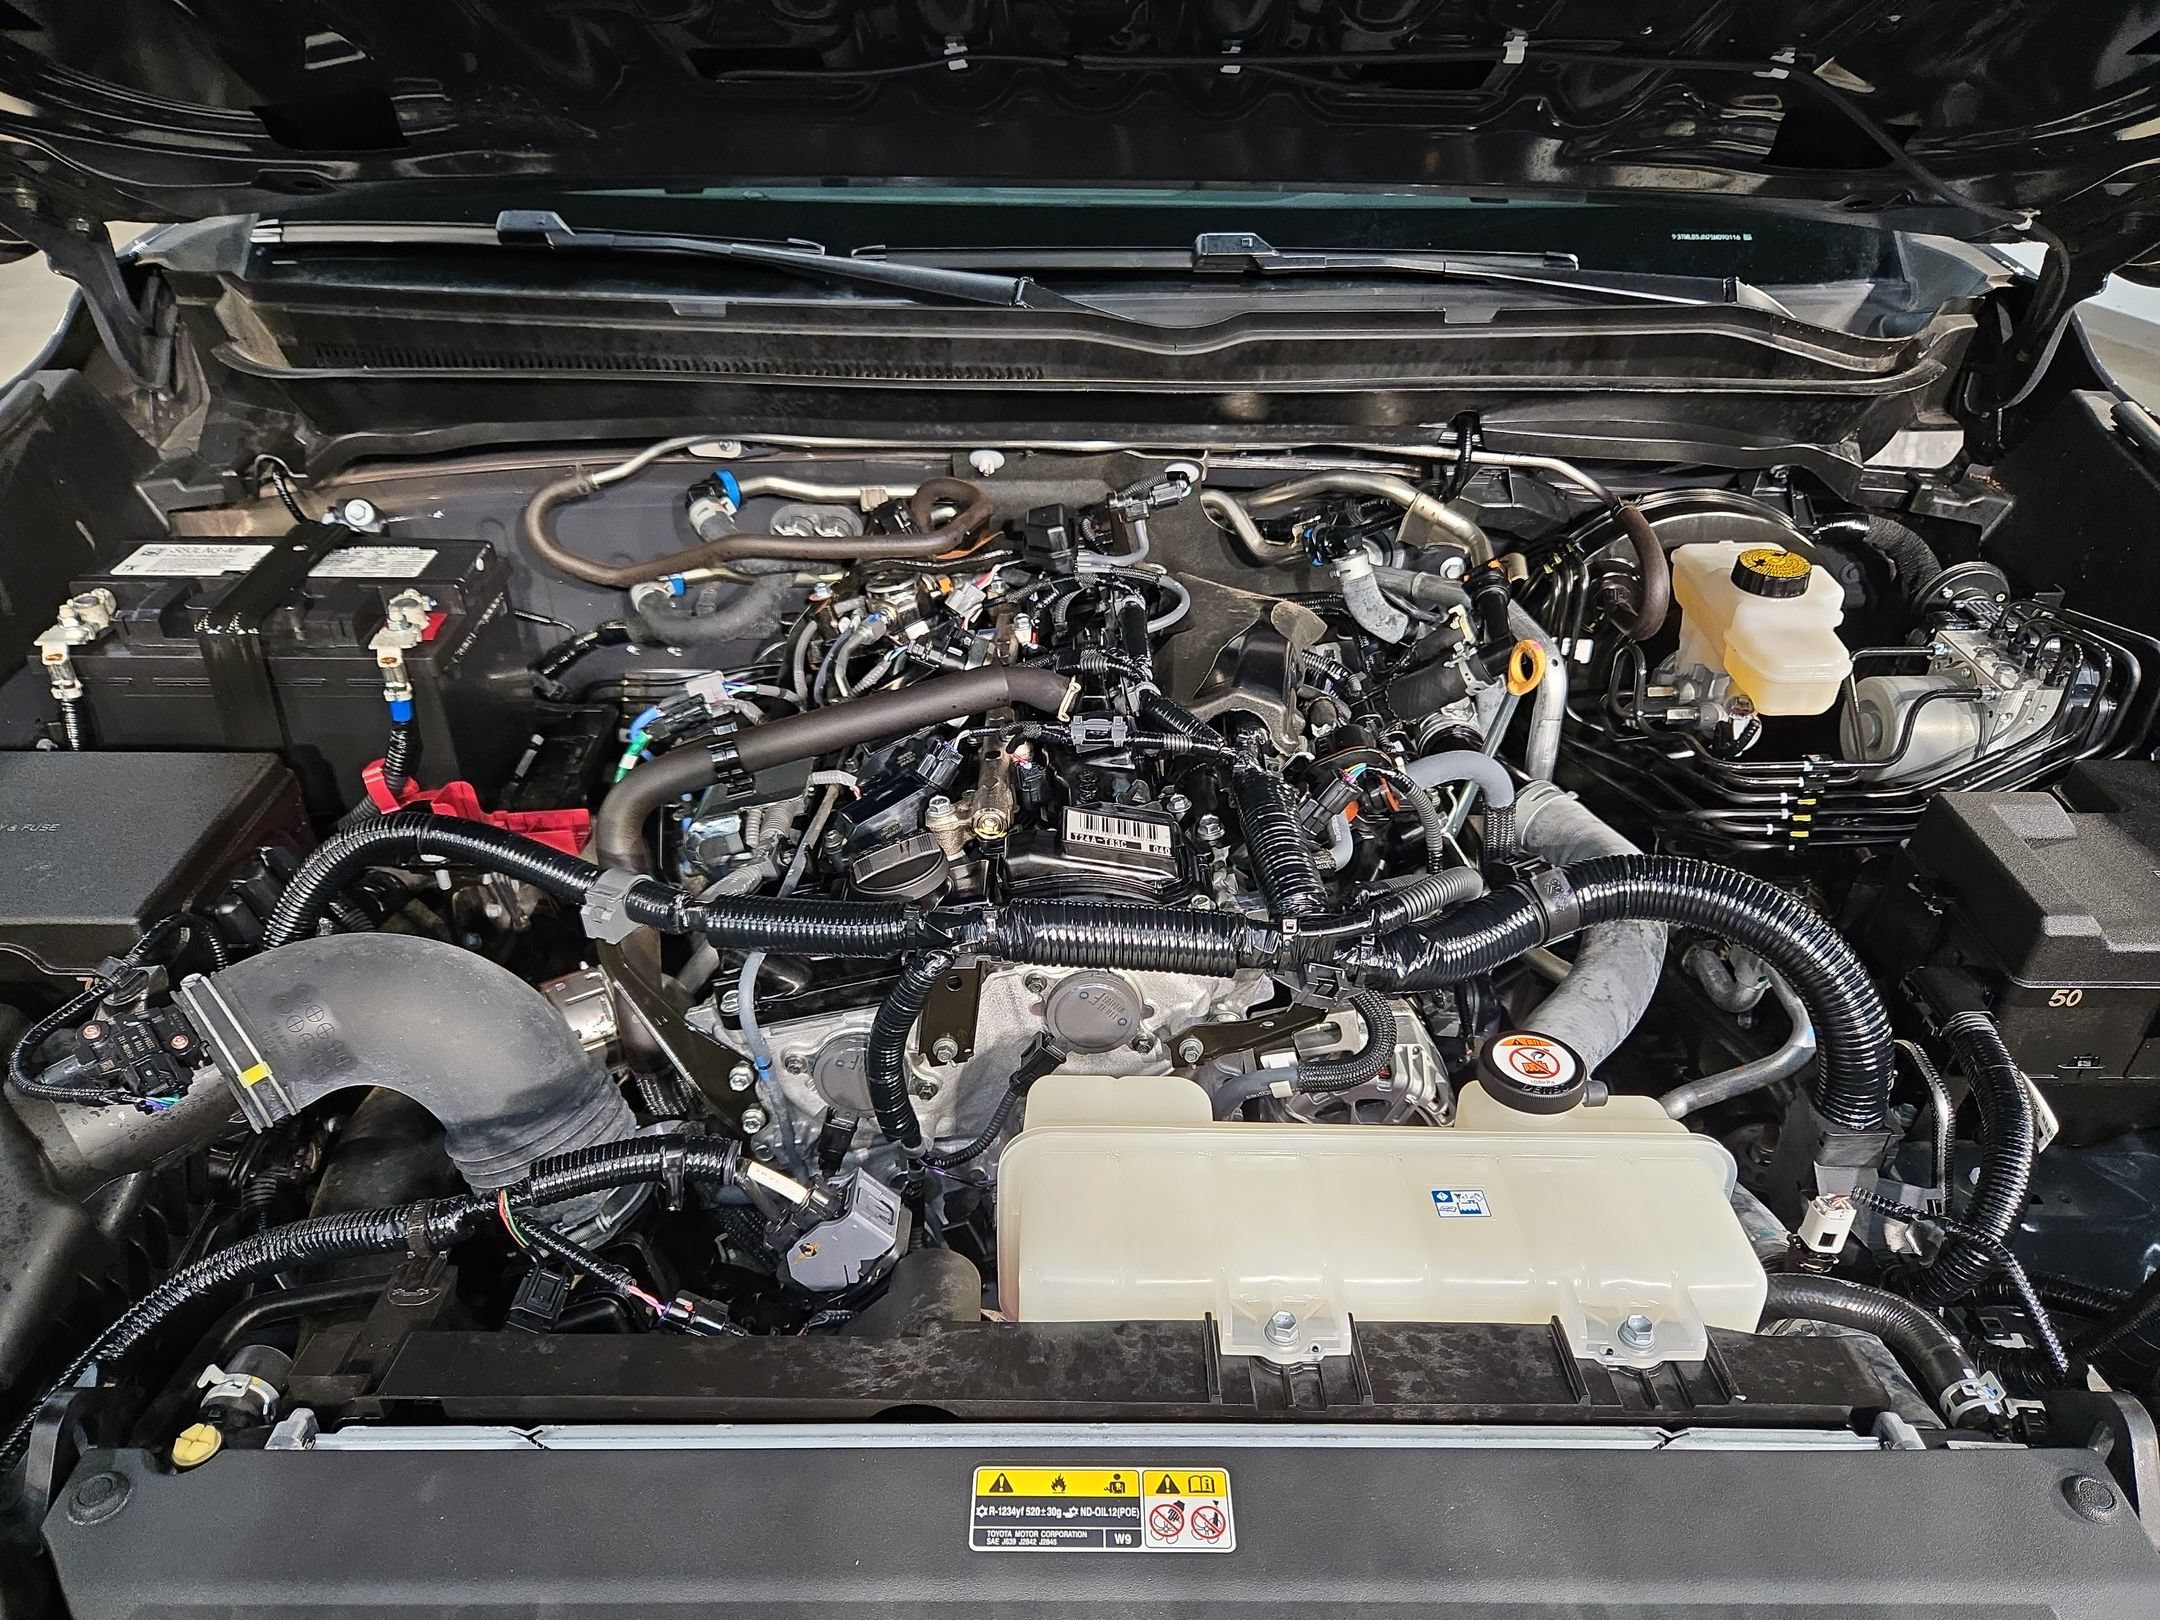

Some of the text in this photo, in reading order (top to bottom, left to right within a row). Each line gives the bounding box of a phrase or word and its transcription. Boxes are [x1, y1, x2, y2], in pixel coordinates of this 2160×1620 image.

[21, 823, 60, 832] FUSE
[2048, 989, 2083, 1007] 50
[988, 1506, 1062, 1518] R-1234yf 520±30g
[1080, 1506, 1140, 1519] ND-OIL12(POE)
[987, 1530, 1088, 1538] TOYOTA MOTOR CORPORATION
[1114, 1533, 1132, 1545] W9
[1001, 1538, 1017, 1546] J639
